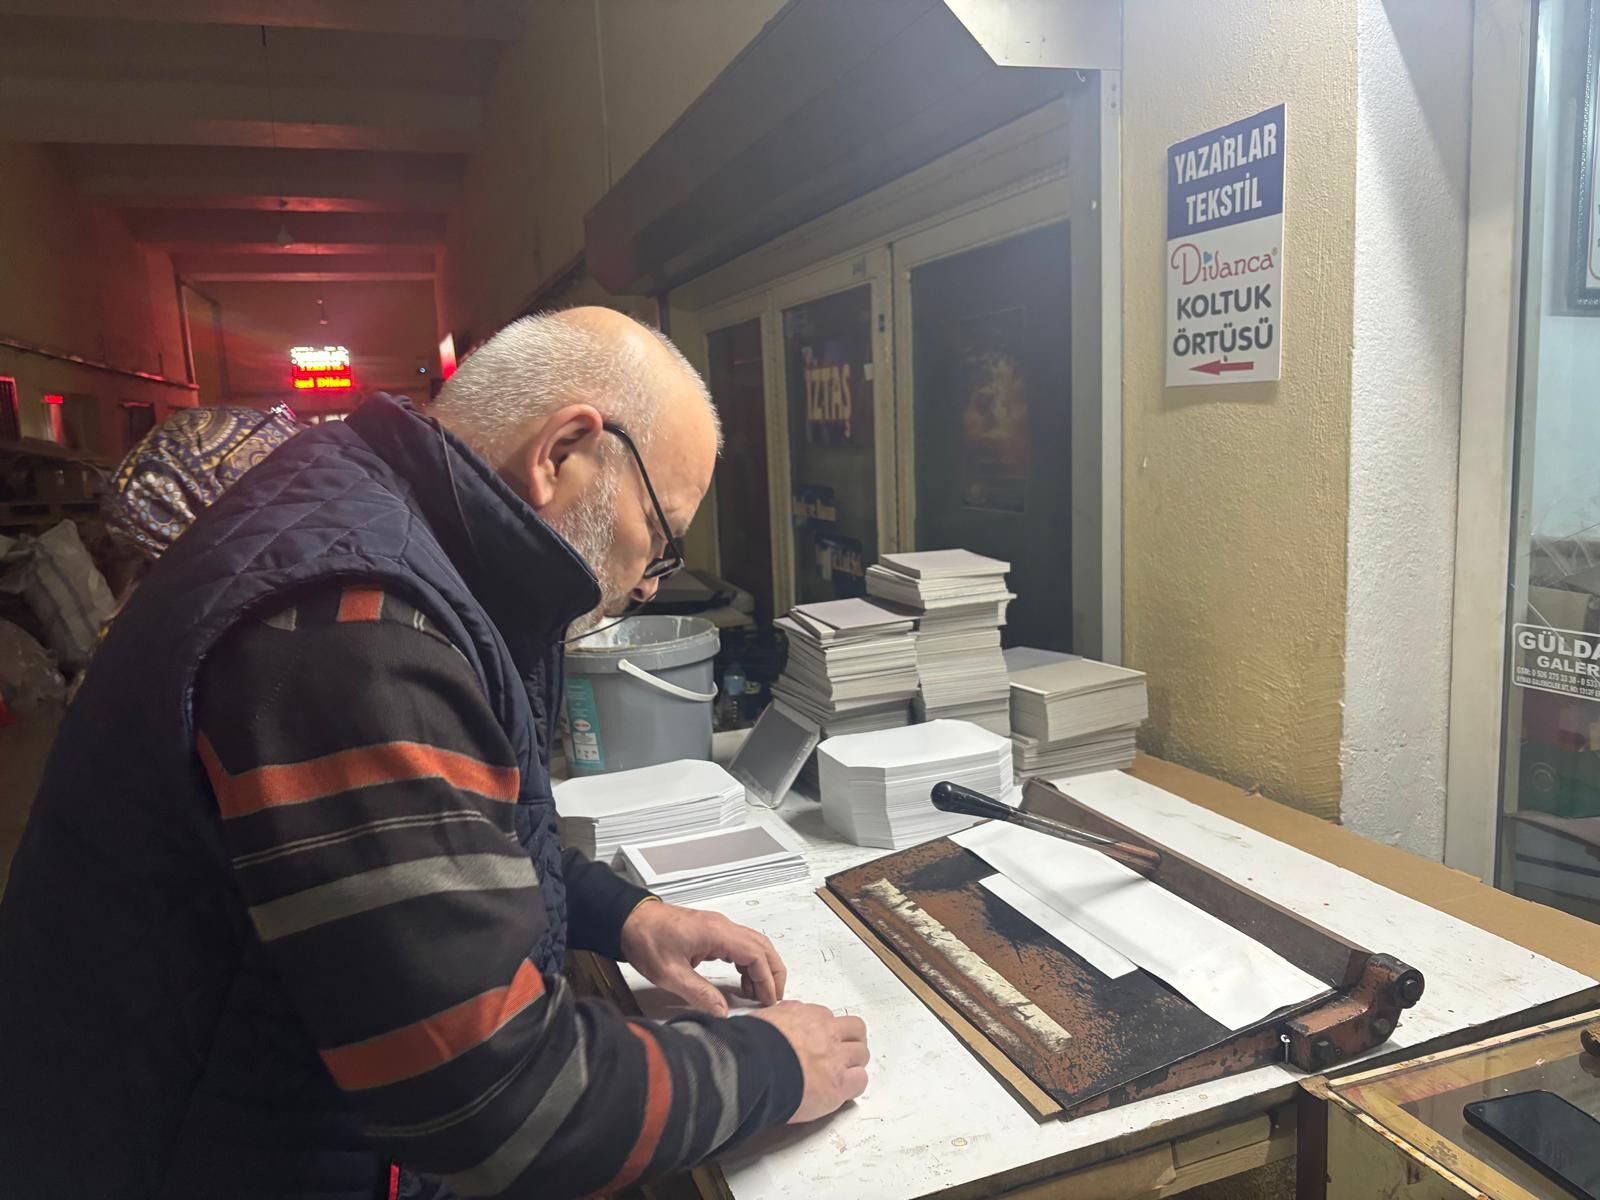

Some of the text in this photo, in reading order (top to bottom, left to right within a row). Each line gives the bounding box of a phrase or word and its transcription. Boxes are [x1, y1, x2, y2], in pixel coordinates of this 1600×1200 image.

[1174, 122, 1278, 185] YAZARLAR
[1185, 173, 1263, 225] TEKSTİL
[1176, 284, 1272, 321] KOLTUK
[1172, 317, 1273, 357] ÖRTÜSÜ
